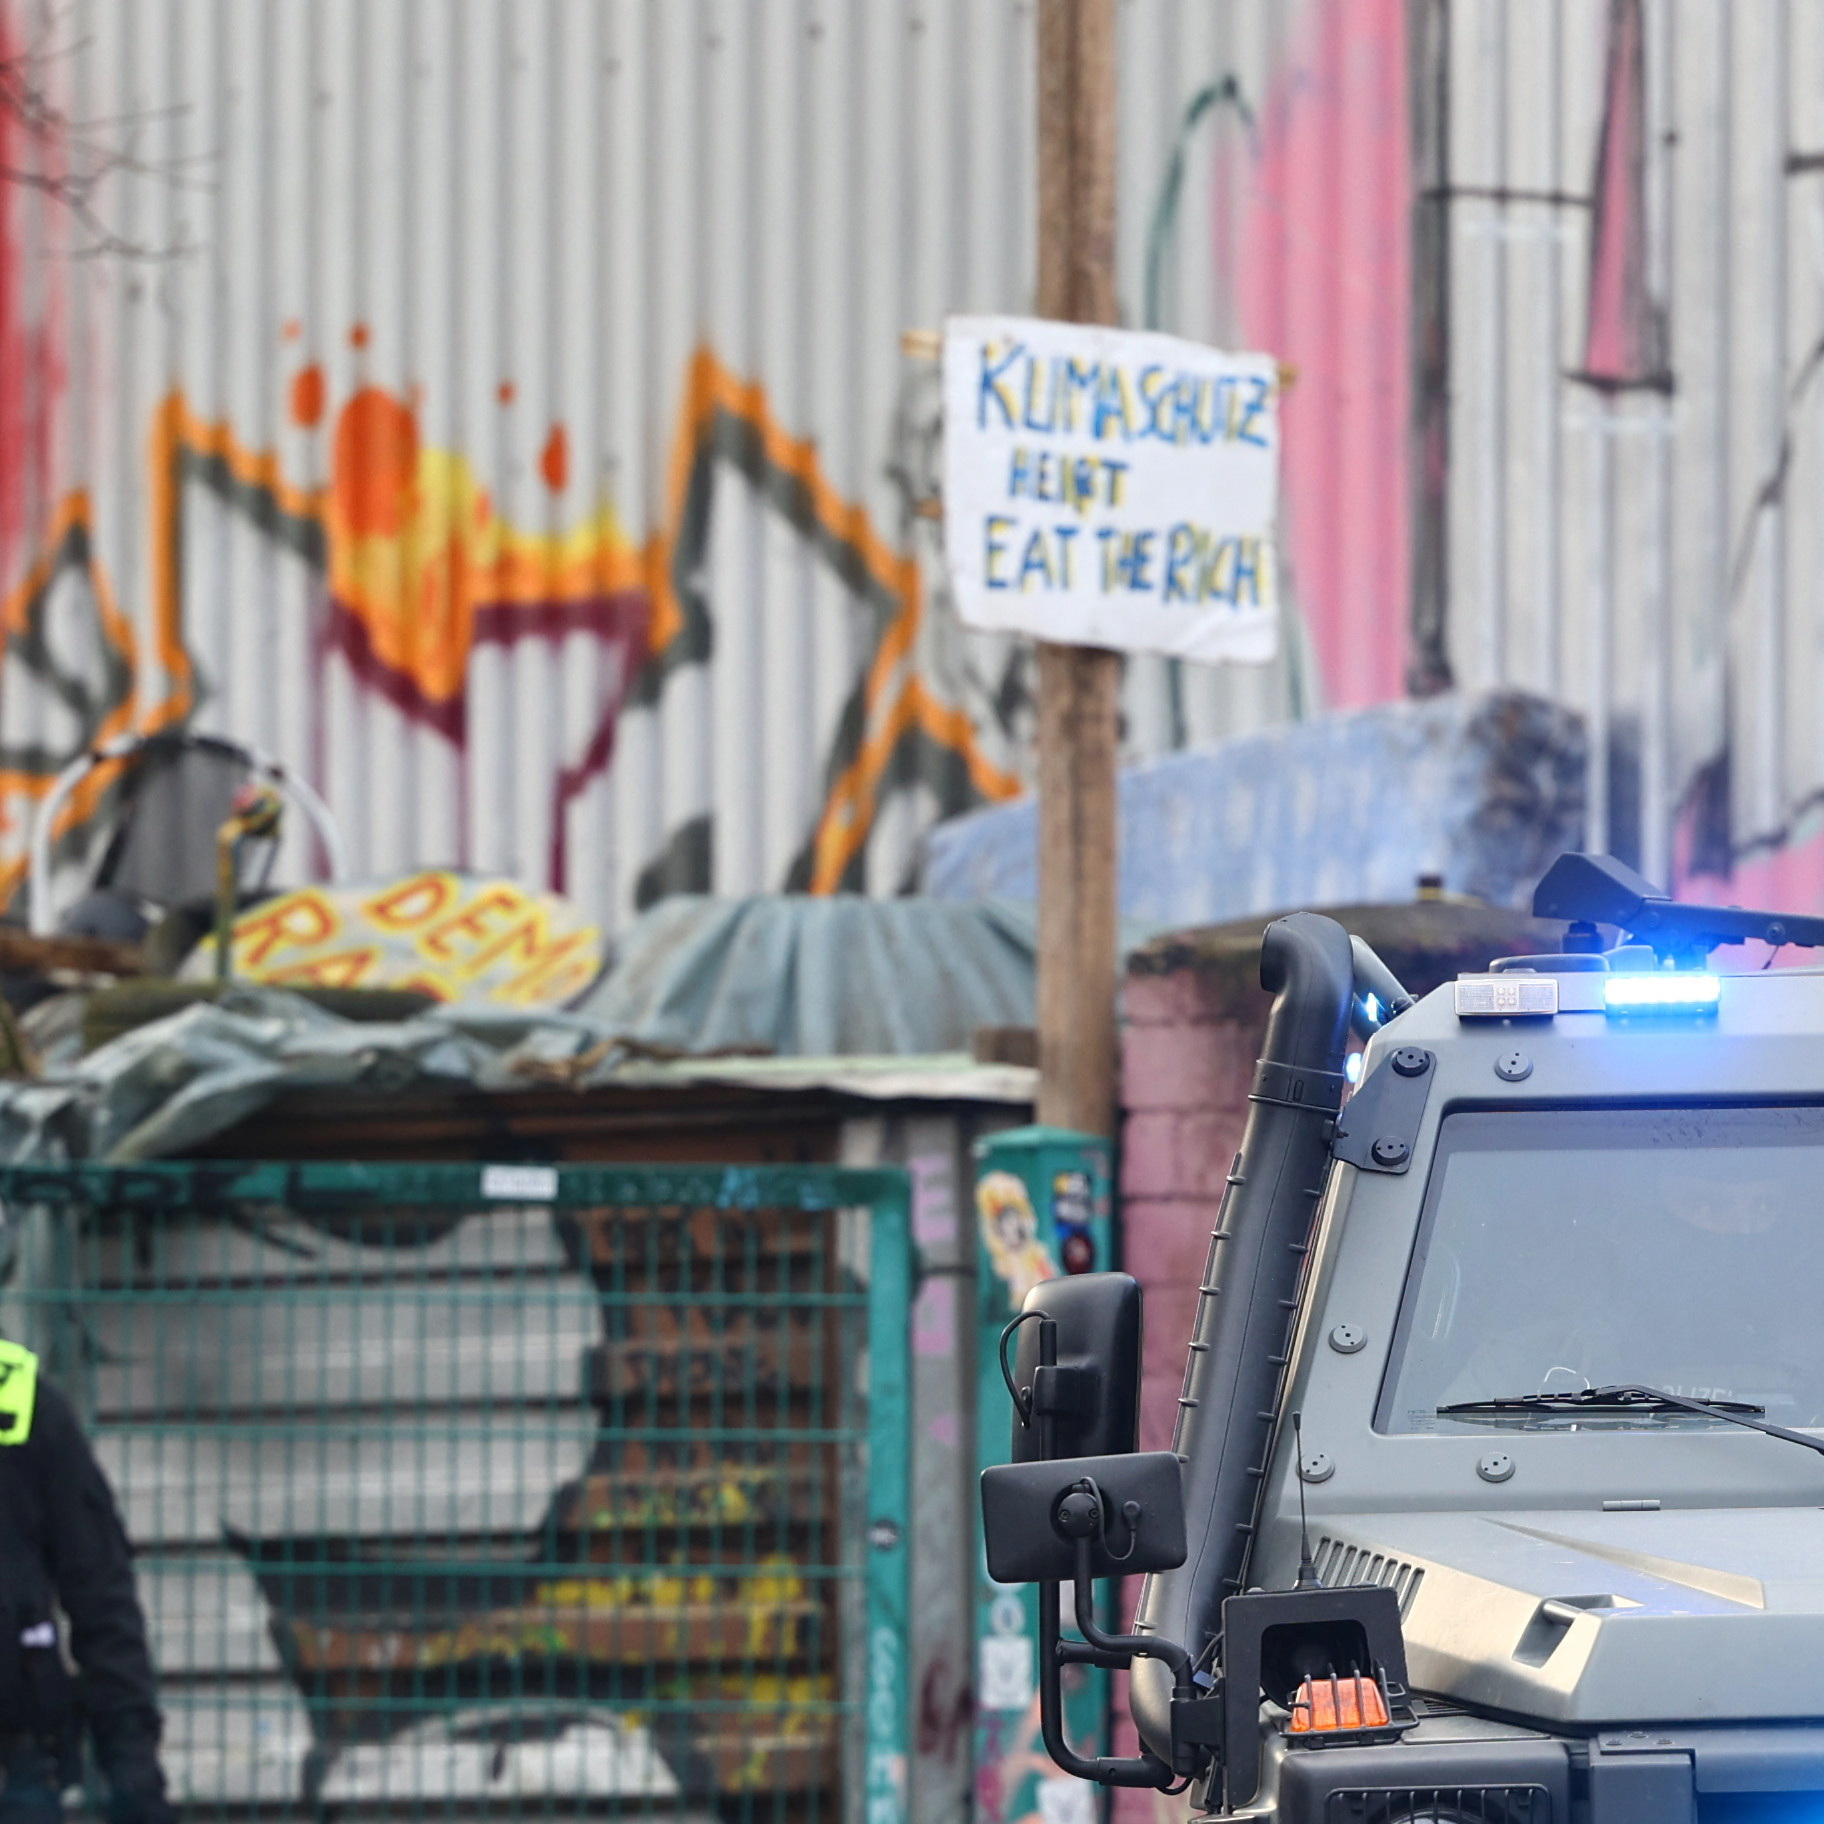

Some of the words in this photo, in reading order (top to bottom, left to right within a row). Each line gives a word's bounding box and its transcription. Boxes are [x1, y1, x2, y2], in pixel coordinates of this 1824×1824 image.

[978, 340, 1268, 447] KLIMASCHUTZ
[985, 514, 1079, 592] EAT
[1096, 527, 1155, 592] THE
[1164, 522, 1269, 607] RICH
